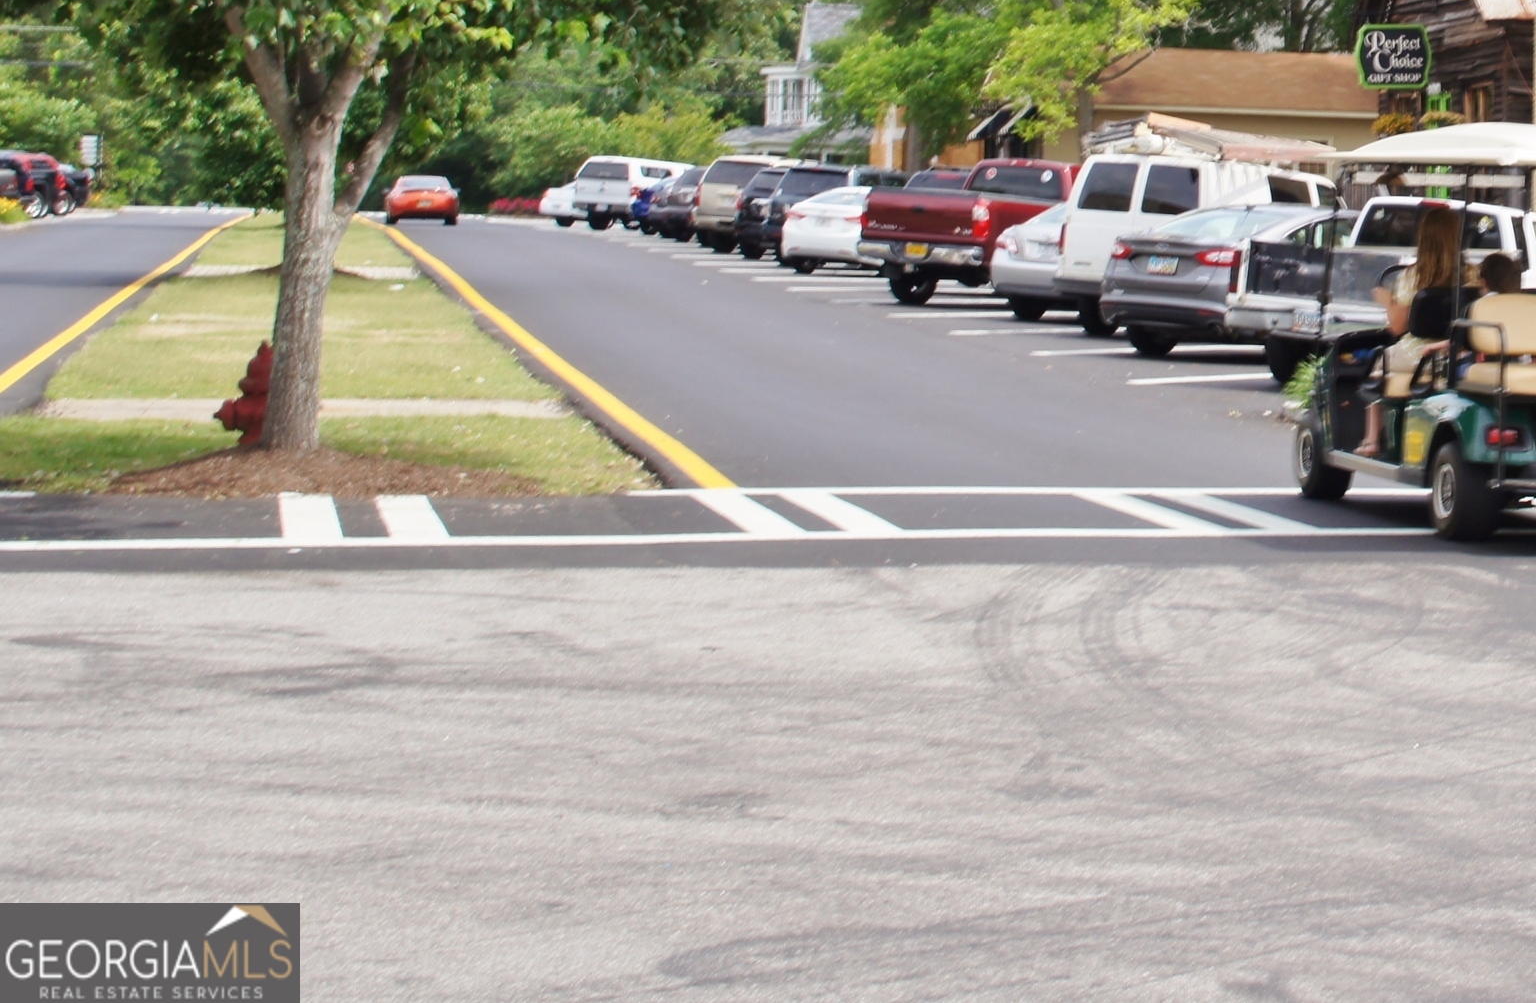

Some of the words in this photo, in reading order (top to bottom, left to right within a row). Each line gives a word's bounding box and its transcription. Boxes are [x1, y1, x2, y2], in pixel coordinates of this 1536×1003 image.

[1364, 30, 1421, 58] Perfect
[1373, 49, 1424, 73] Choice
[1367, 73, 1393, 83] GIFT
[1392, 73, 1422, 83] SHOP
